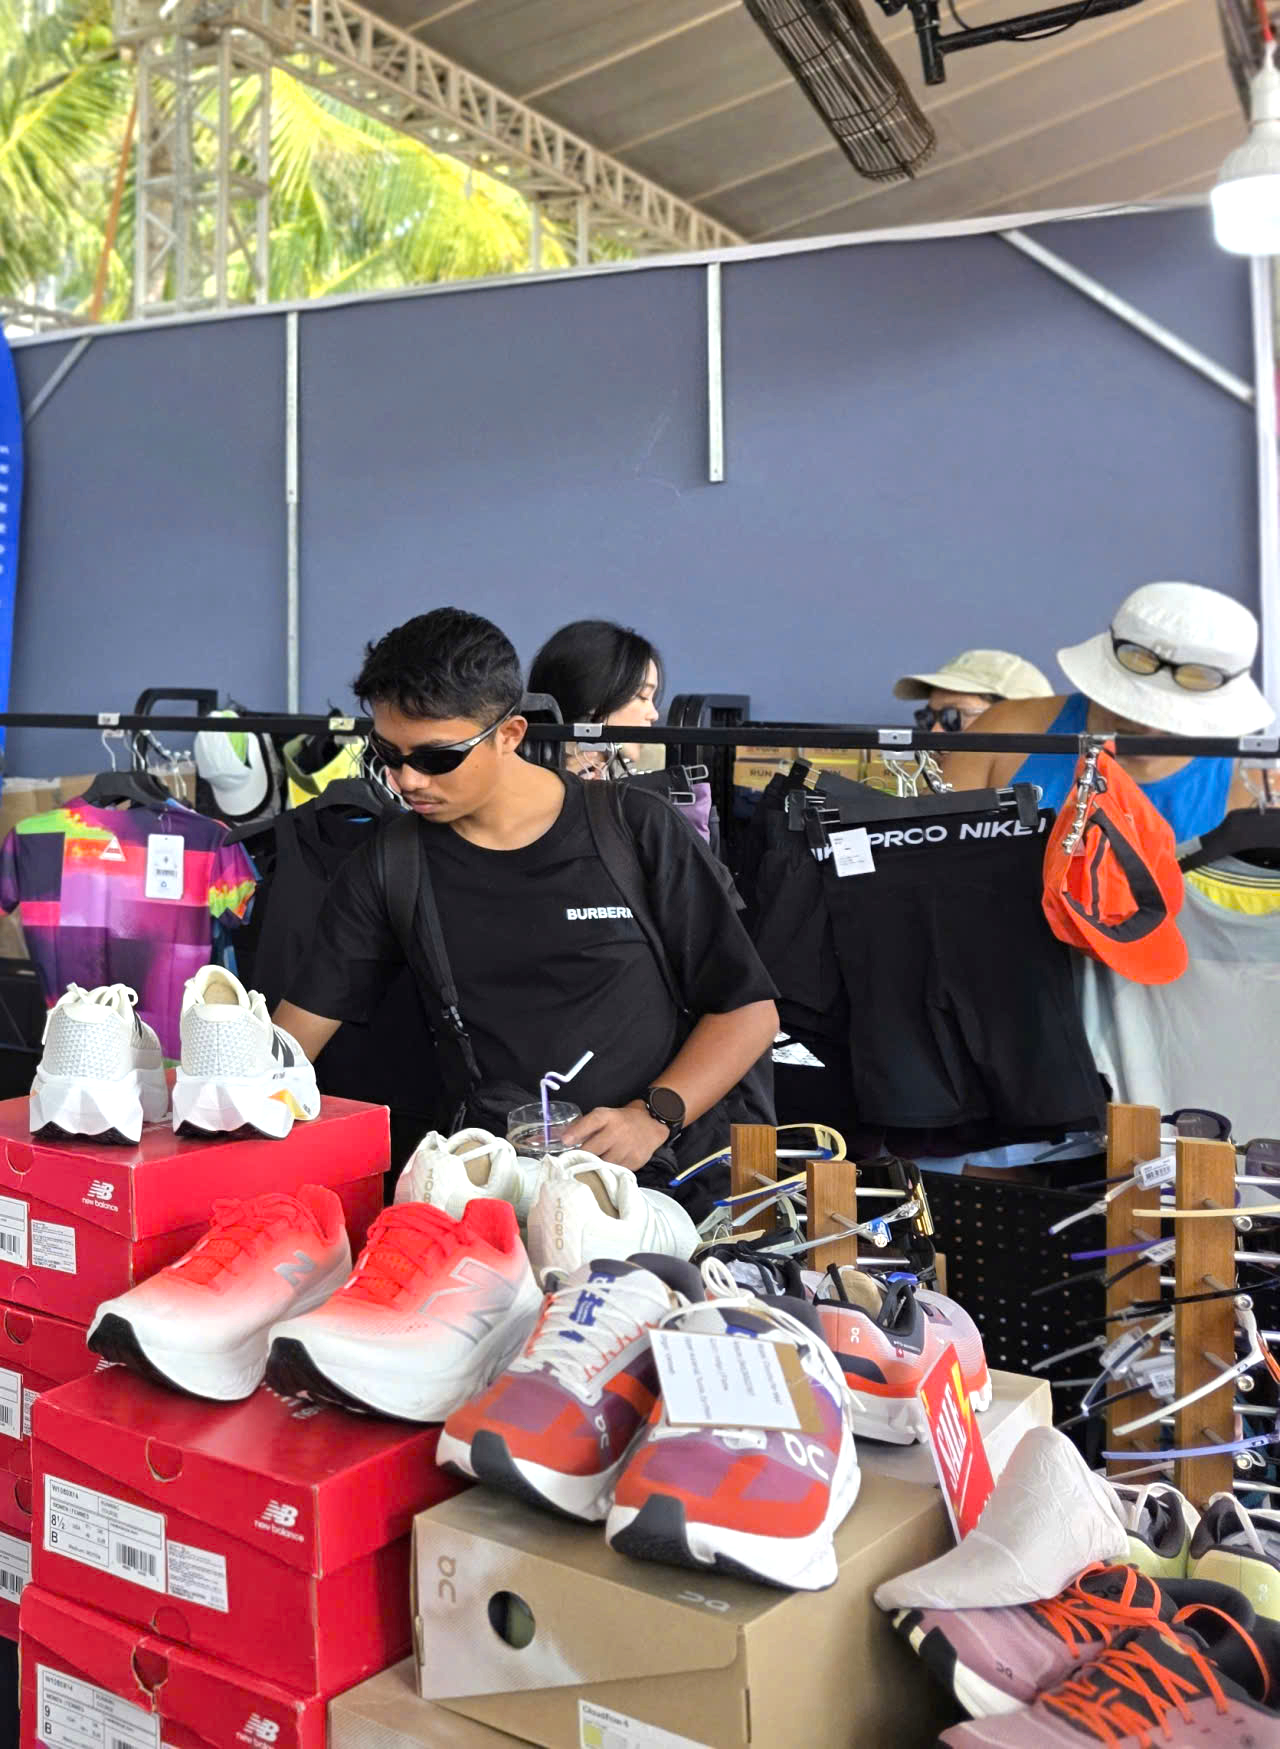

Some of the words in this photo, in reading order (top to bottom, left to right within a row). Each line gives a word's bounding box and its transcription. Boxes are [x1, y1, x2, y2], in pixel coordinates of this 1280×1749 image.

[959, 820, 1033, 840] NIKE
[566, 906, 634, 921] BURBER
[554, 1198, 565, 1250] 1080
[934, 1382, 967, 1494] SALE
[51, 1530, 58, 1543] B
[44, 1704, 50, 1717] 9
[45, 1721, 51, 1735] B
